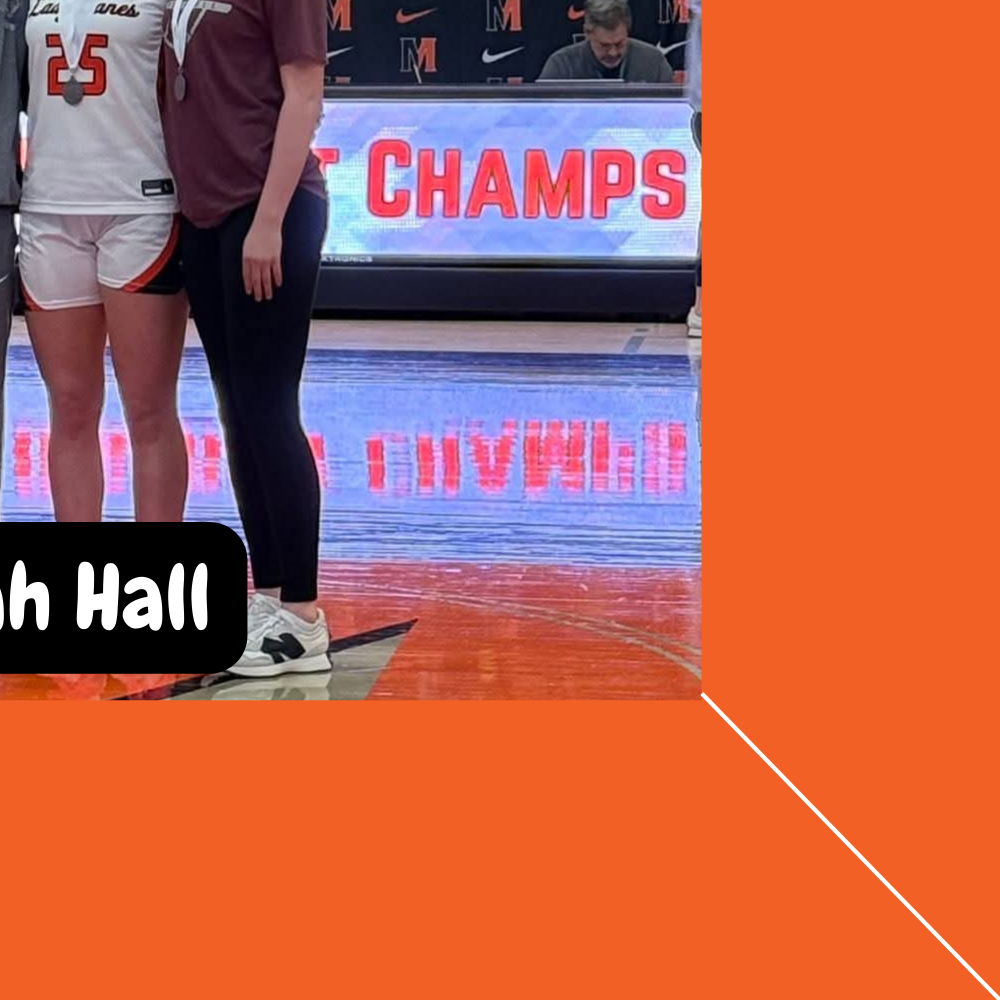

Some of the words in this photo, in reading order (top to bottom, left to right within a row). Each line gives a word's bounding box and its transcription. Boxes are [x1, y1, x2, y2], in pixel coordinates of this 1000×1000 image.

[93, 2, 140, 18] anes
[45, 33, 109, 96] 25
[400, 37, 437, 72] M
[367, 138, 687, 220] CHAMPS
